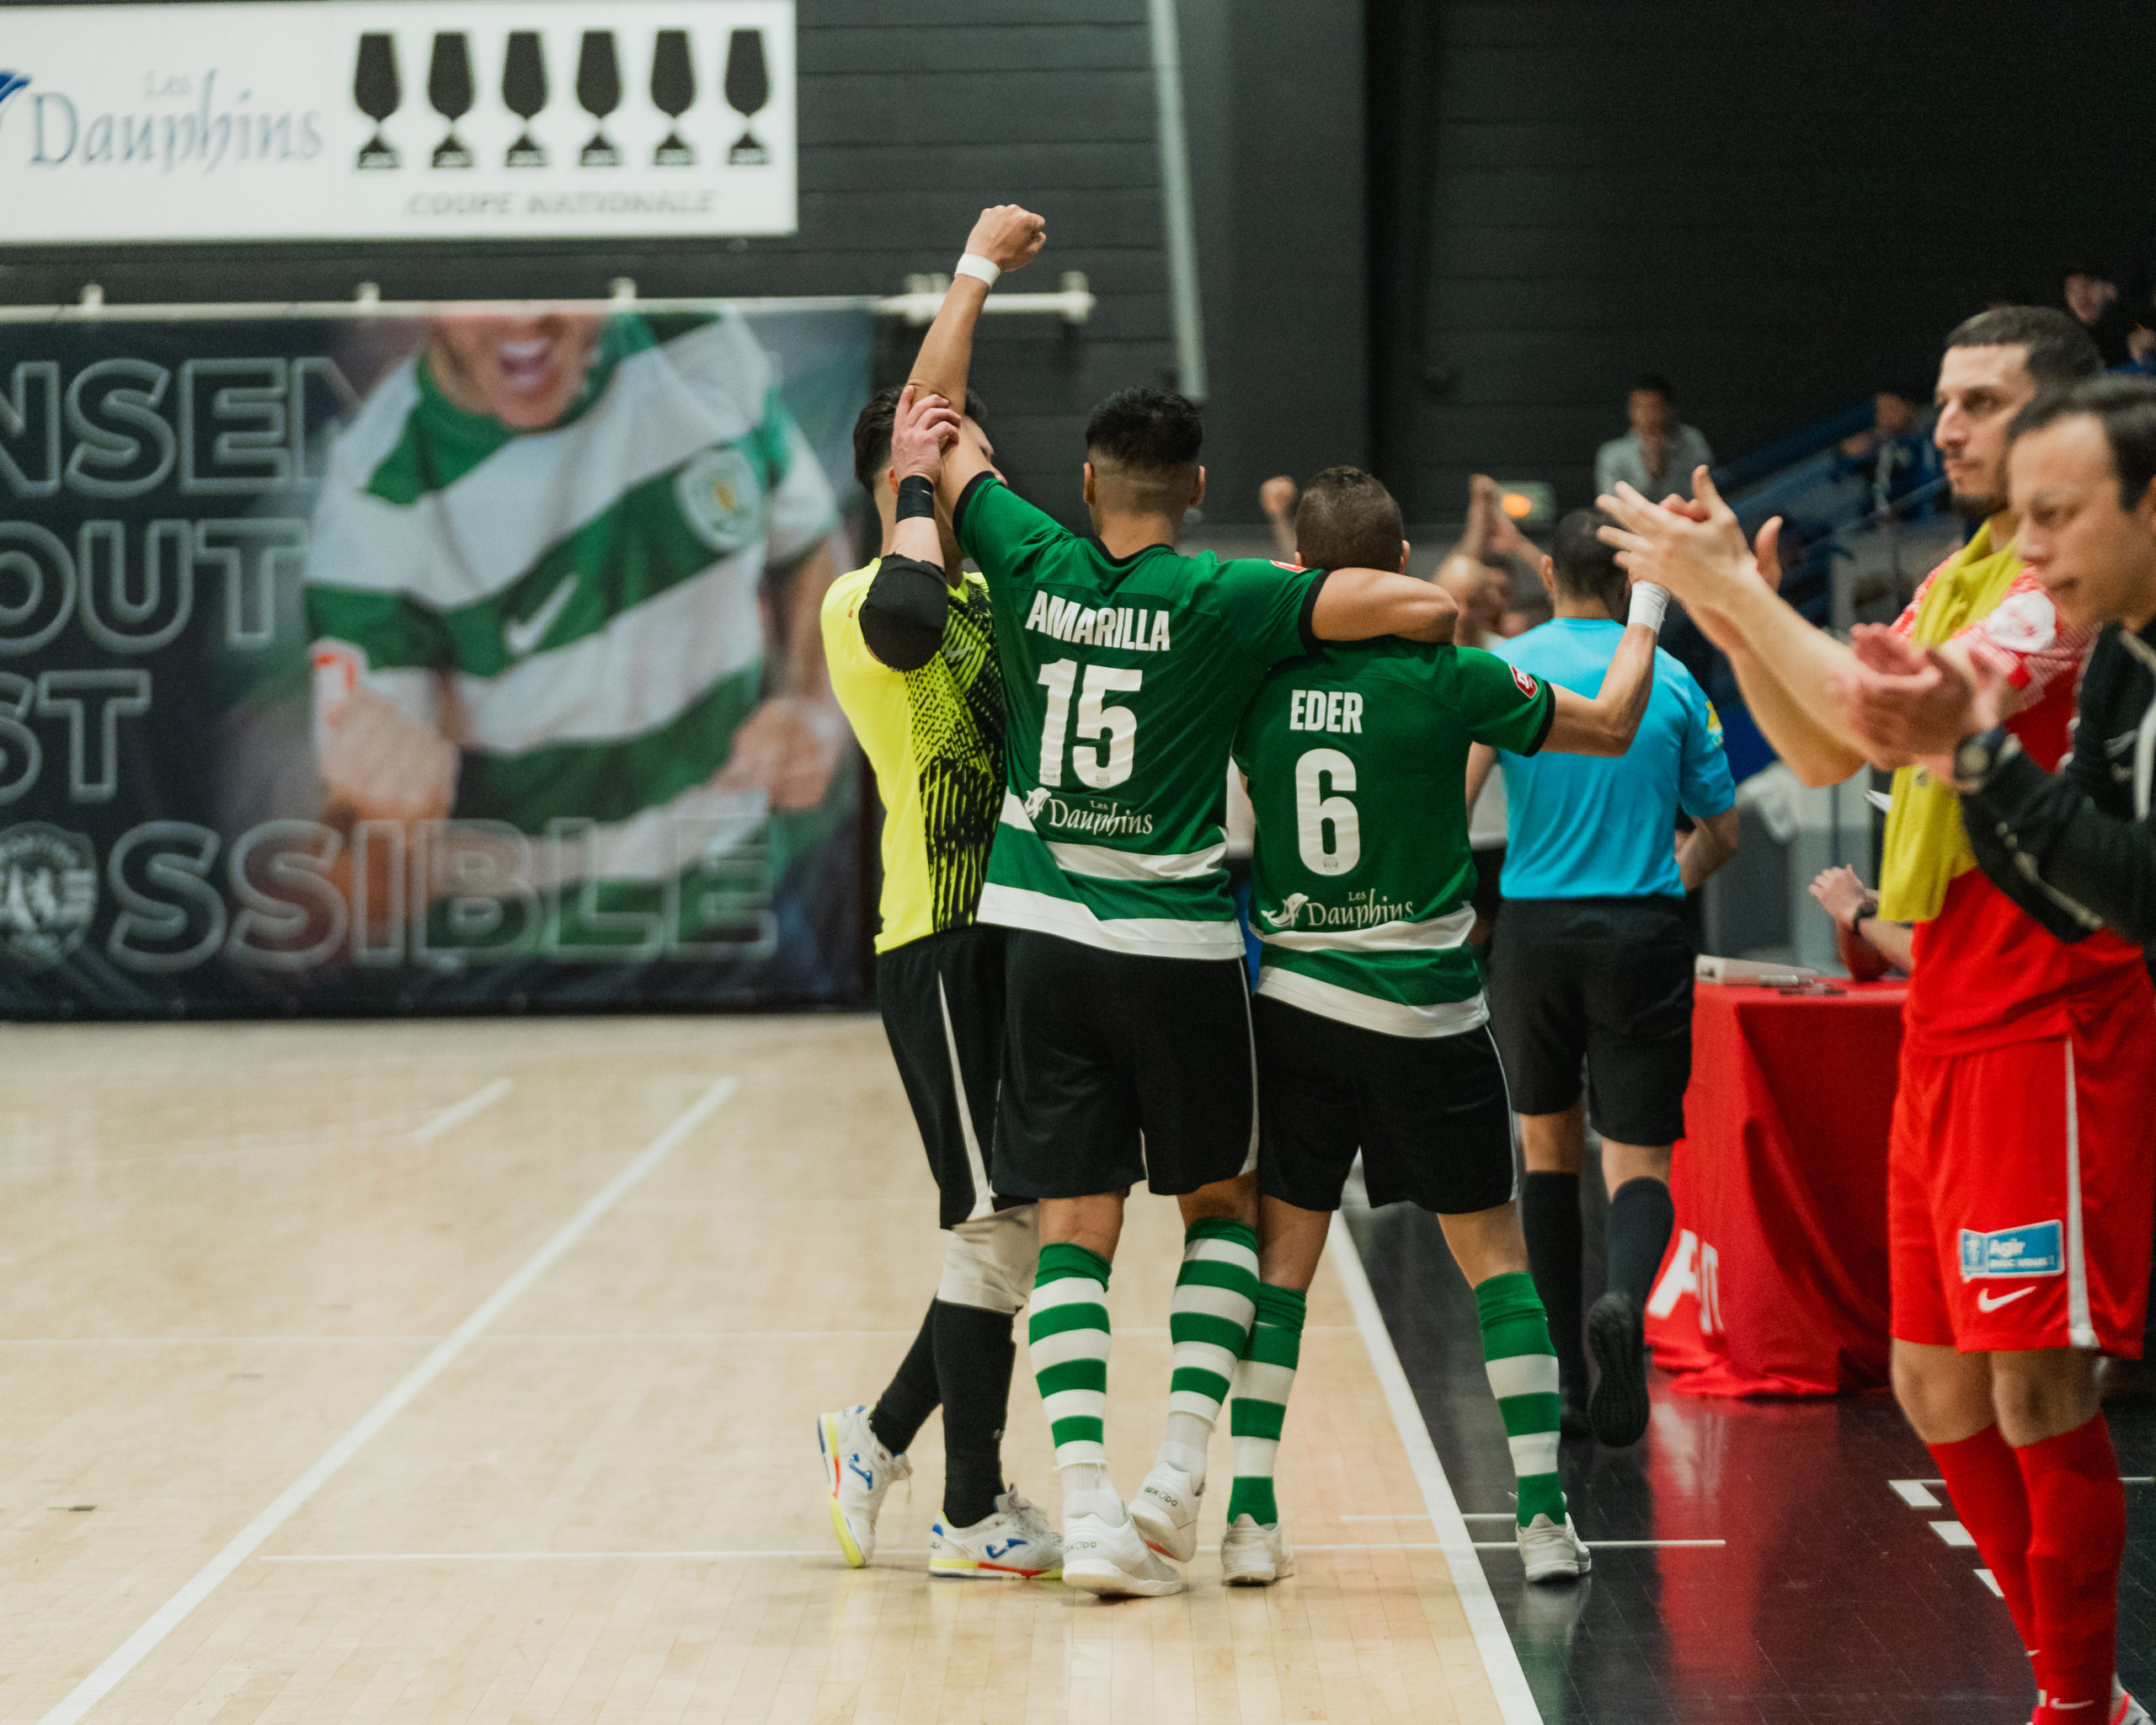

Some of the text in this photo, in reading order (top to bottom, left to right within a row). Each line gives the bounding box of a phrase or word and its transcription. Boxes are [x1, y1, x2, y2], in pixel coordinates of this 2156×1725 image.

[144, 68, 193, 95] Les
[29, 67, 323, 174] Dauphins
[407, 190, 718, 215] COUPE NATIONALE
[1026, 590, 1171, 652] AMARILLA
[1038, 658, 1143, 789] 15
[1289, 689, 1364, 734] EDER
[1049, 798, 1153, 837] Dauphins
[1090, 800, 1108, 810] Les
[1295, 748, 1361, 876] 6
[1305, 888, 1415, 928] Dauphins
[1348, 891, 1366, 901] Les
